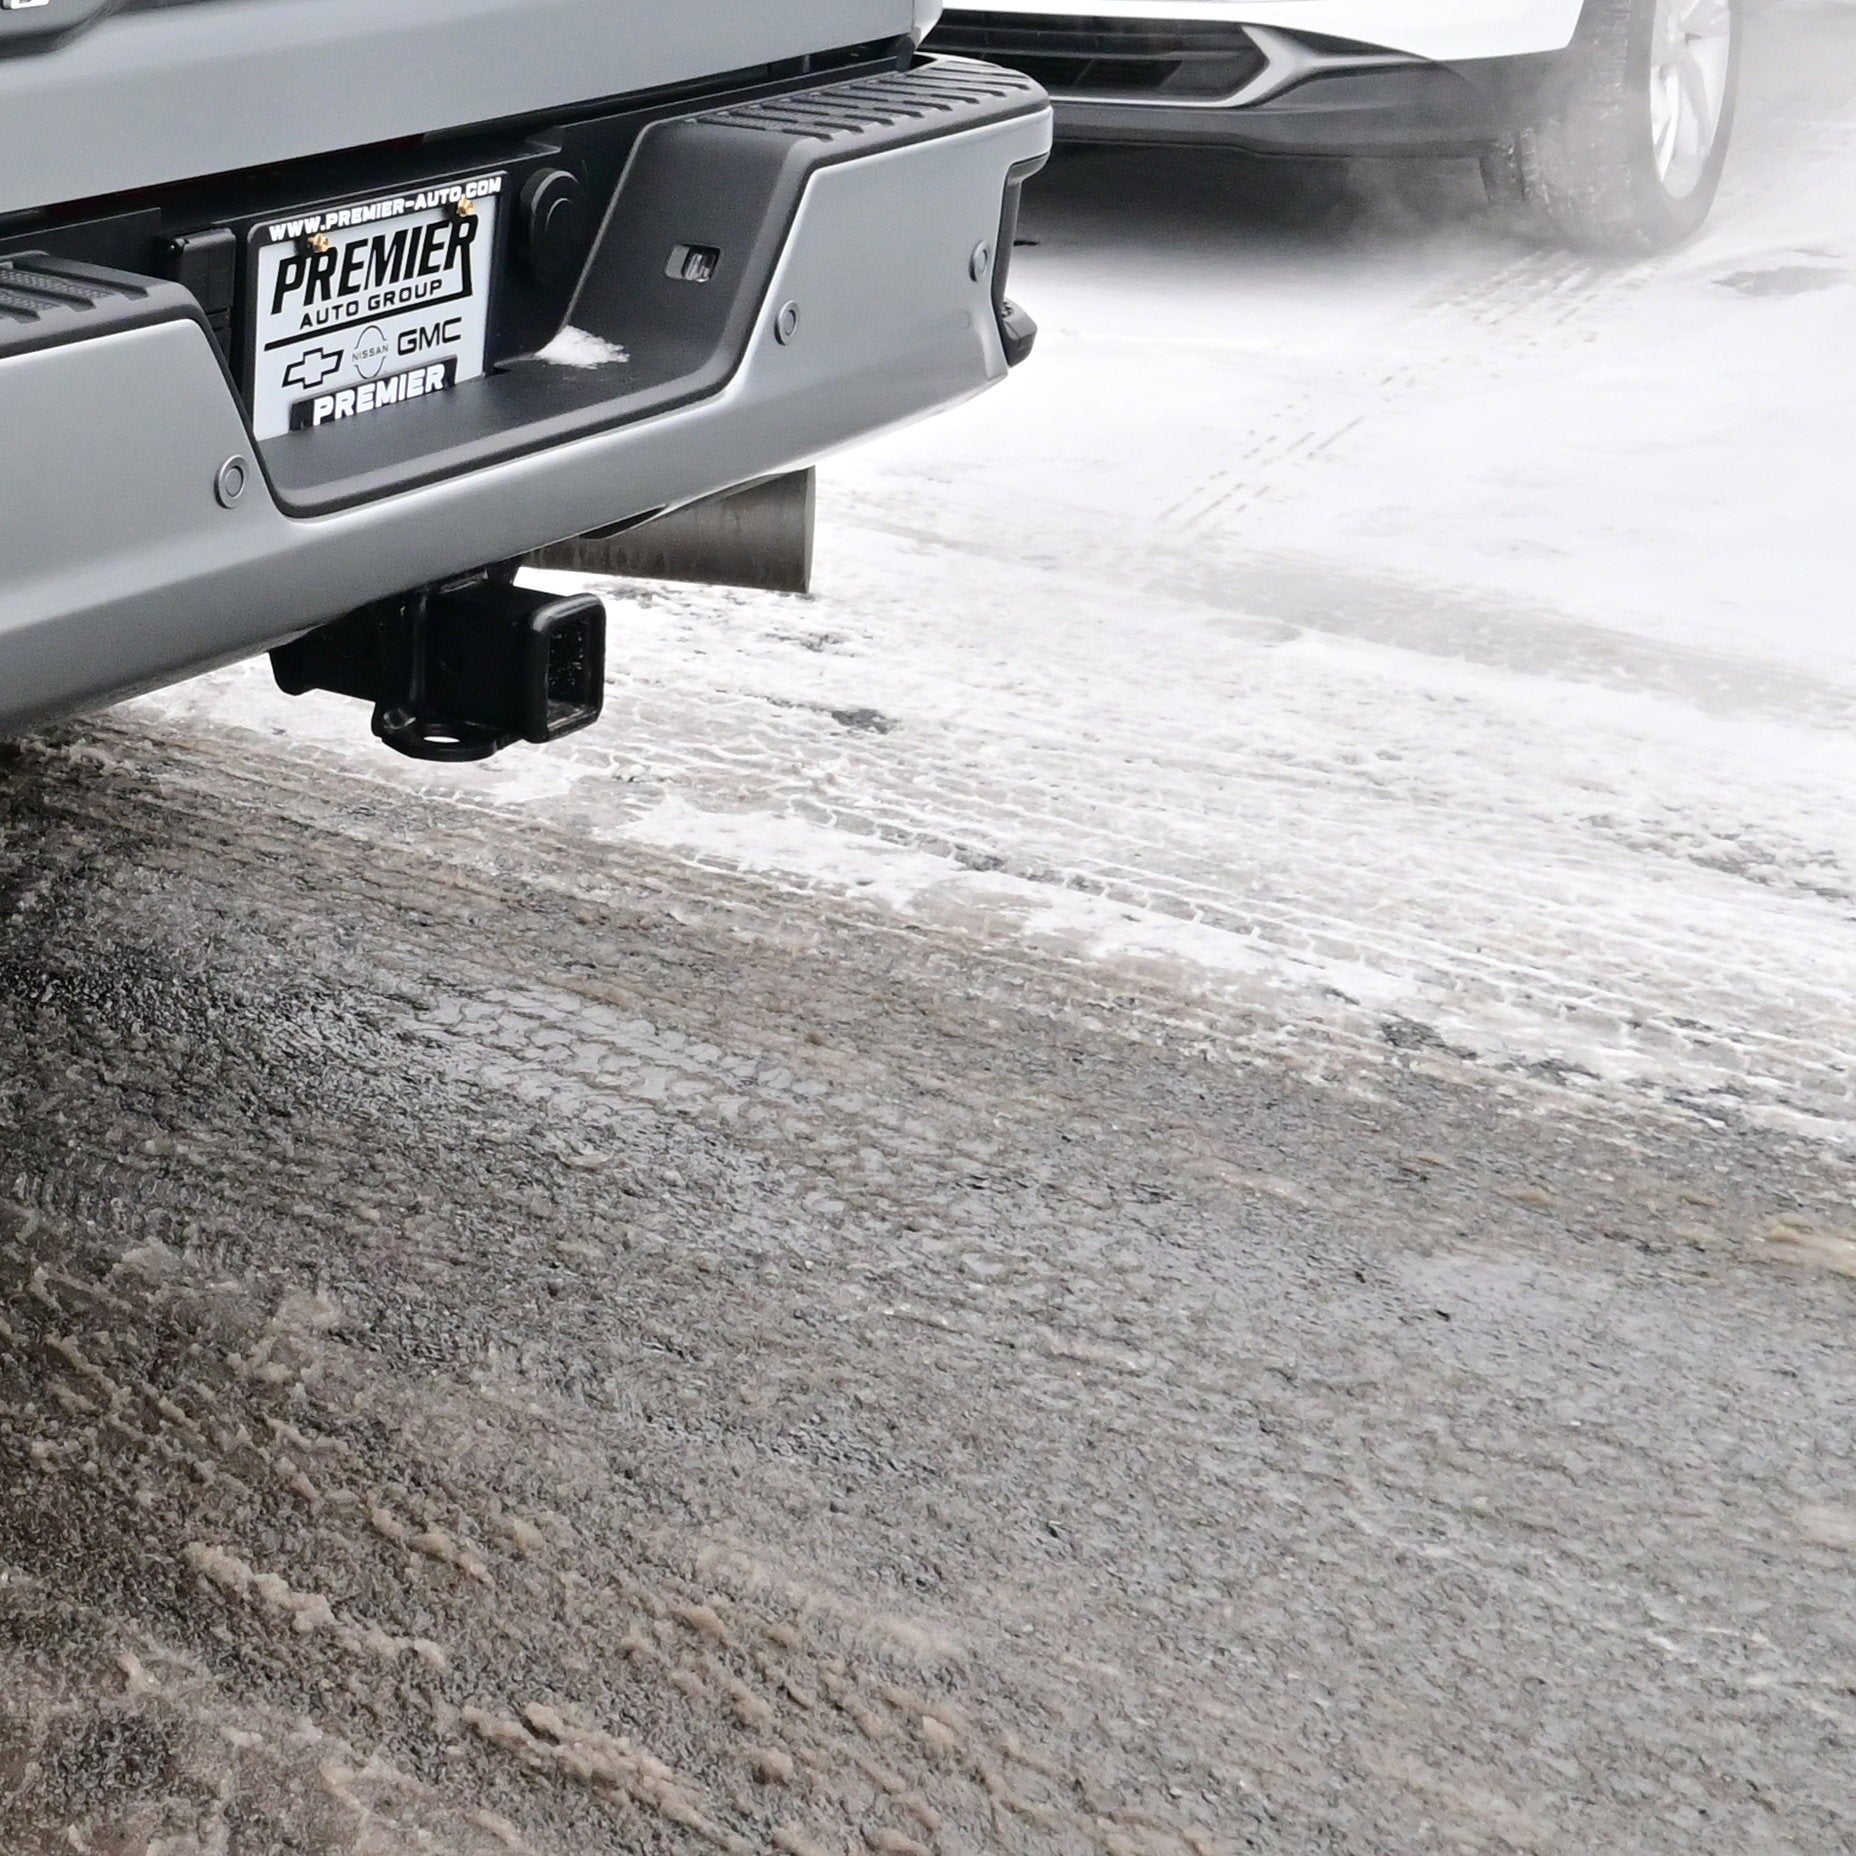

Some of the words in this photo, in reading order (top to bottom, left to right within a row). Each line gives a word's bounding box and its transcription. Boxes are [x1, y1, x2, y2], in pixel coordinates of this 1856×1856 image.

[269, 176, 502, 242] WWW.PREMIER-AUTO.COM
[270, 215, 479, 315] PREMIER
[299, 300, 359, 330] AUTO
[368, 279, 444, 311] GROUP
[352, 344, 389, 362] NISSAN
[397, 317, 463, 355] GMC
[313, 363, 447, 427] PREMIER
